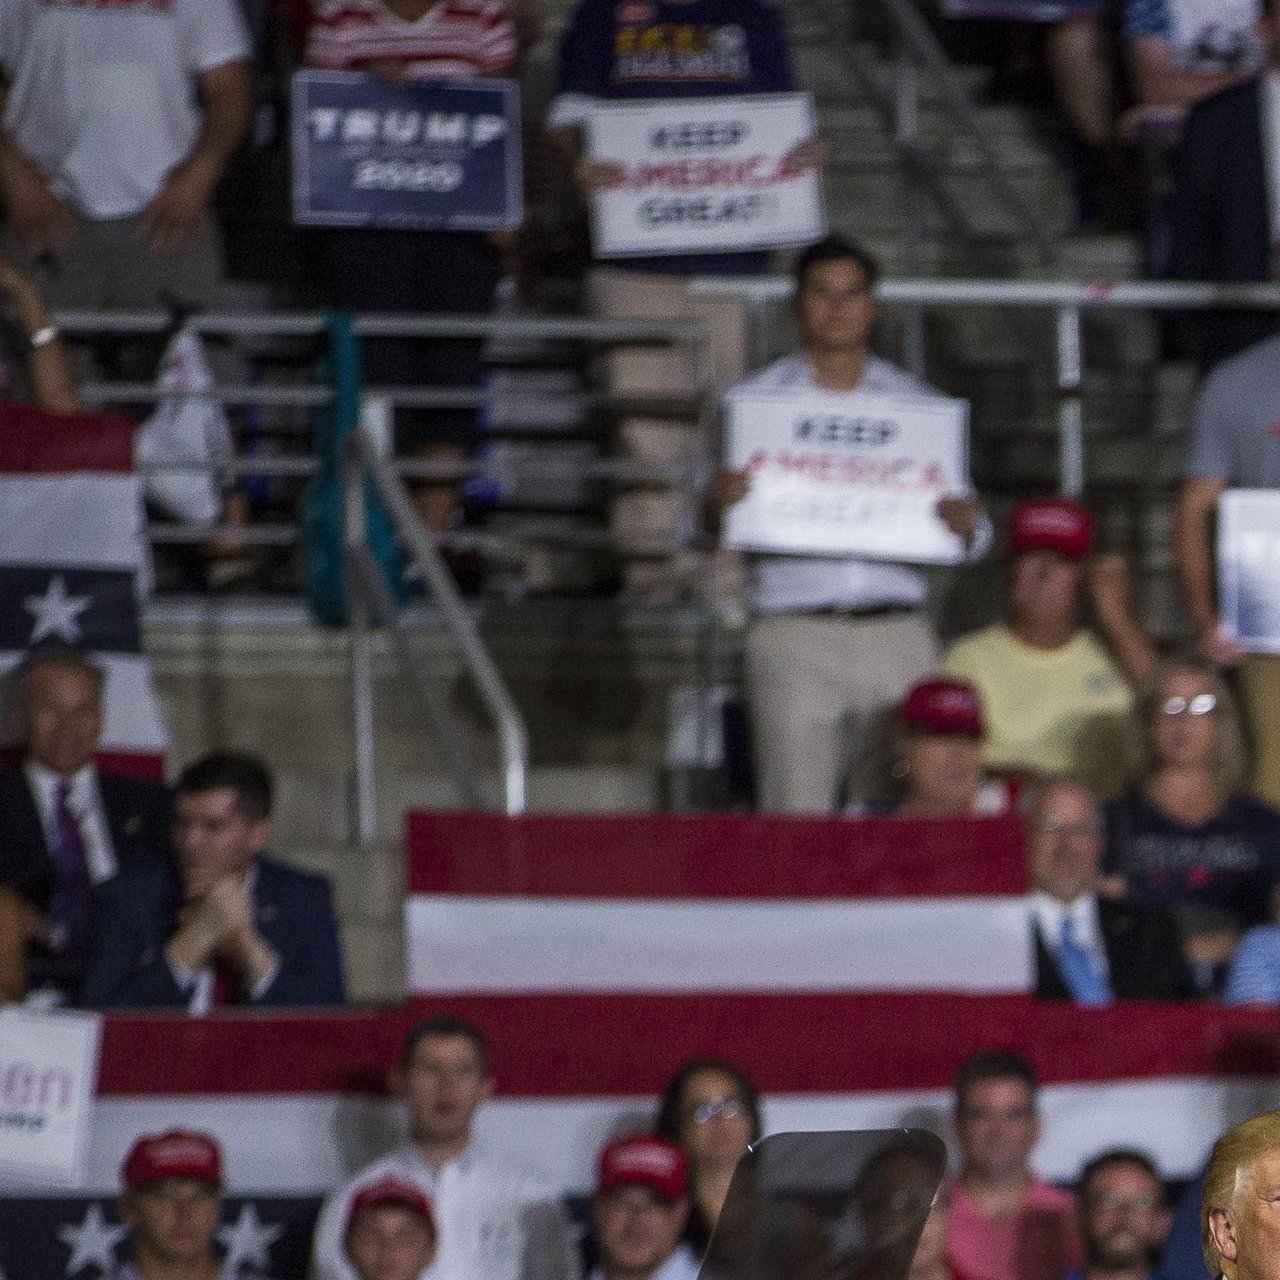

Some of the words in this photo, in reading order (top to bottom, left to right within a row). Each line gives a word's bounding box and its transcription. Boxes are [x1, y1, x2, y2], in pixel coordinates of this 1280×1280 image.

[309, 107, 505, 147] TRUMP
[650, 121, 748, 151] KEEP
[354, 160, 464, 191] 2020
[796, 413, 898, 447] KEEP
